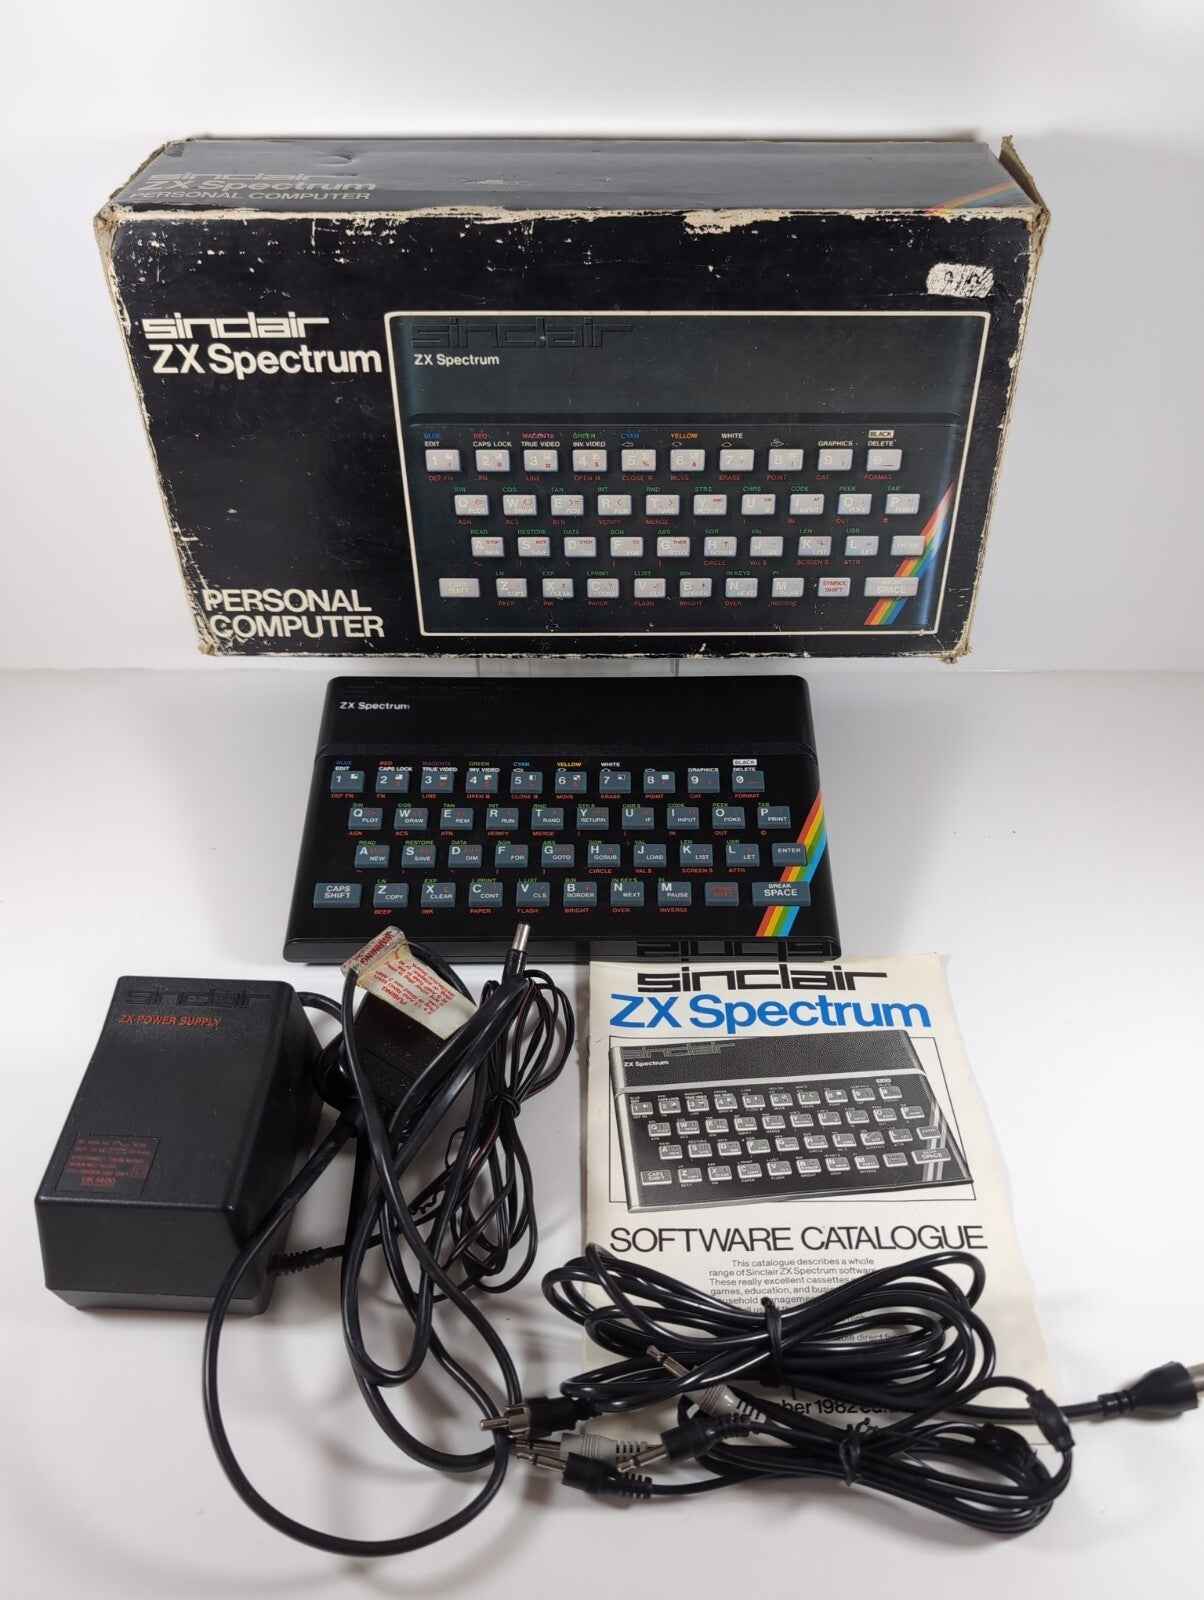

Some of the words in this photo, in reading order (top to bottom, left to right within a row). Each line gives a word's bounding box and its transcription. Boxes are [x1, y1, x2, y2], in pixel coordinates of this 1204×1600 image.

[137, 180, 193, 191] ZX
[198, 180, 377, 191] Spectrum
[129, 191, 240, 199] PERSONAL
[249, 192, 371, 200] COMPUTER
[141, 312, 330, 339] sinclair
[148, 344, 206, 374] ZX
[207, 344, 383, 380] Spectrum
[414, 354, 434, 366] ZX
[436, 353, 501, 369] Spectrum
[721, 432, 744, 440] WHITE
[202, 588, 372, 612] PERSONAL
[209, 615, 384, 638] COMPUTER
[339, 702, 355, 710] ZX
[380, 775, 389, 784] 2
[424, 775, 433, 784] 3
[469, 776, 477, 784] 4
[514, 776, 522, 785] 5
[558, 776, 567, 785] 6
[602, 776, 610, 784] 7
[647, 776, 656, 784] 8
[691, 776, 699, 784] 9
[353, 808, 363, 818] Q
[399, 809, 411, 818] W
[443, 809, 453, 818] E
[489, 809, 498, 818] R
[535, 809, 544, 817] T
[580, 809, 588, 817] Y
[625, 809, 634, 817] U
[671, 809, 675, 817] I
[715, 809, 725, 817] O
[760, 809, 769, 817] P
[359, 847, 369, 855] A
[405, 847, 415, 855] S
[451, 847, 461, 855] D
[497, 846, 505, 855] F
[544, 846, 553, 854] G
[590, 846, 600, 854] H
[637, 845, 645, 854] J
[682, 845, 692, 854] K
[728, 845, 737, 854] L
[377, 885, 387, 894] Z
[425, 885, 435, 894] X
[472, 884, 482, 893] C
[521, 884, 530, 893] V
[566, 884, 576, 892] B
[613, 883, 623, 892] N
[661, 882, 673, 892] M
[764, 888, 798, 897] SPACE
[637, 963, 888, 992] sinclair
[609, 993, 682, 1028] ZX
[689, 993, 932, 1034] Spectrum
[137, 1015, 177, 1025] POWER
[179, 1015, 223, 1027] SUPPLY
[635, 1060, 669, 1068] Spectrum
[609, 1227, 793, 1253] SOFTWARE
[800, 1224, 988, 1250] CATALOGUE
[732, 1259, 750, 1267] This
[751, 1259, 796, 1269] catalogue
[799, 1258, 839, 1266] describes
[848, 1257, 874, 1265] whole
[708, 1270, 735, 1278] range
[745, 1268, 778, 1276] Sinclair
[779, 1267, 793, 1275] ZX
[793, 1266, 838, 1276] Spectrum
[709, 1278, 737, 1286] These
[738, 1278, 762, 1287] really
[763, 1277, 805, 1285] excellent
[710, 1288, 744, 1296] games,
[744, 1287, 791, 1295] education,
[793, 1286, 811, 1294] and
